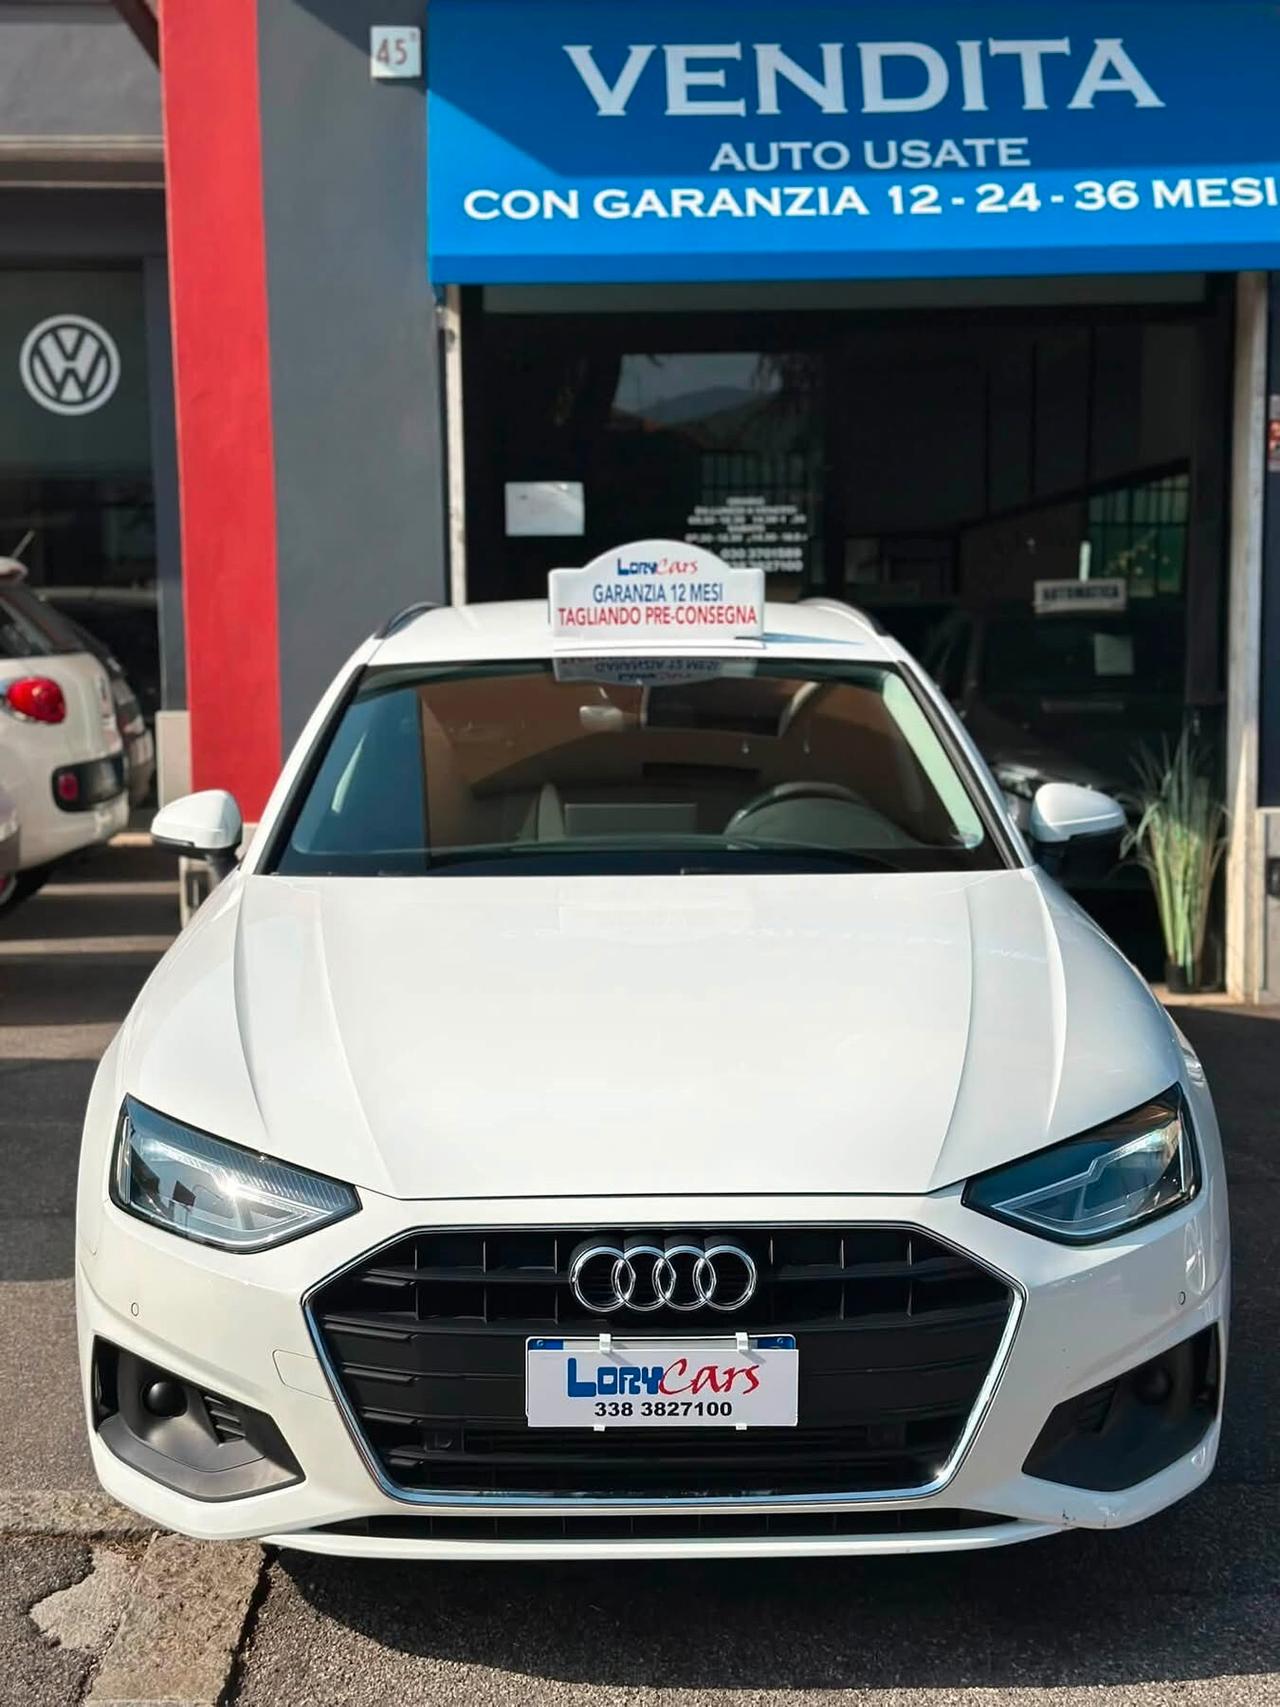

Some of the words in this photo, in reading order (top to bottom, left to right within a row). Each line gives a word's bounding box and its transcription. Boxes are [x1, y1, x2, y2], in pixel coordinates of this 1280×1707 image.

[562, 38, 1166, 117] VENDITA
[709, 140, 851, 173] AUTO
[863, 137, 1031, 169] USATE
[463, 188, 580, 221] CON
[593, 184, 870, 219] GARANZIA
[889, 185, 944, 216] 12
[976, 182, 1040, 214] 24
[1074, 181, 1140, 212] 36
[1151, 177, 1279, 210] MESI
[592, 583, 668, 604] GARANZIA
[671, 583, 687, 602] 12
[689, 582, 724, 602] MESI
[558, 606, 640, 626] TAGLIANDO
[645, 605, 757, 625] PRE-CONSEGNA
[594, 1402, 633, 1417] 338
[640, 1402, 733, 1417] 3827100
